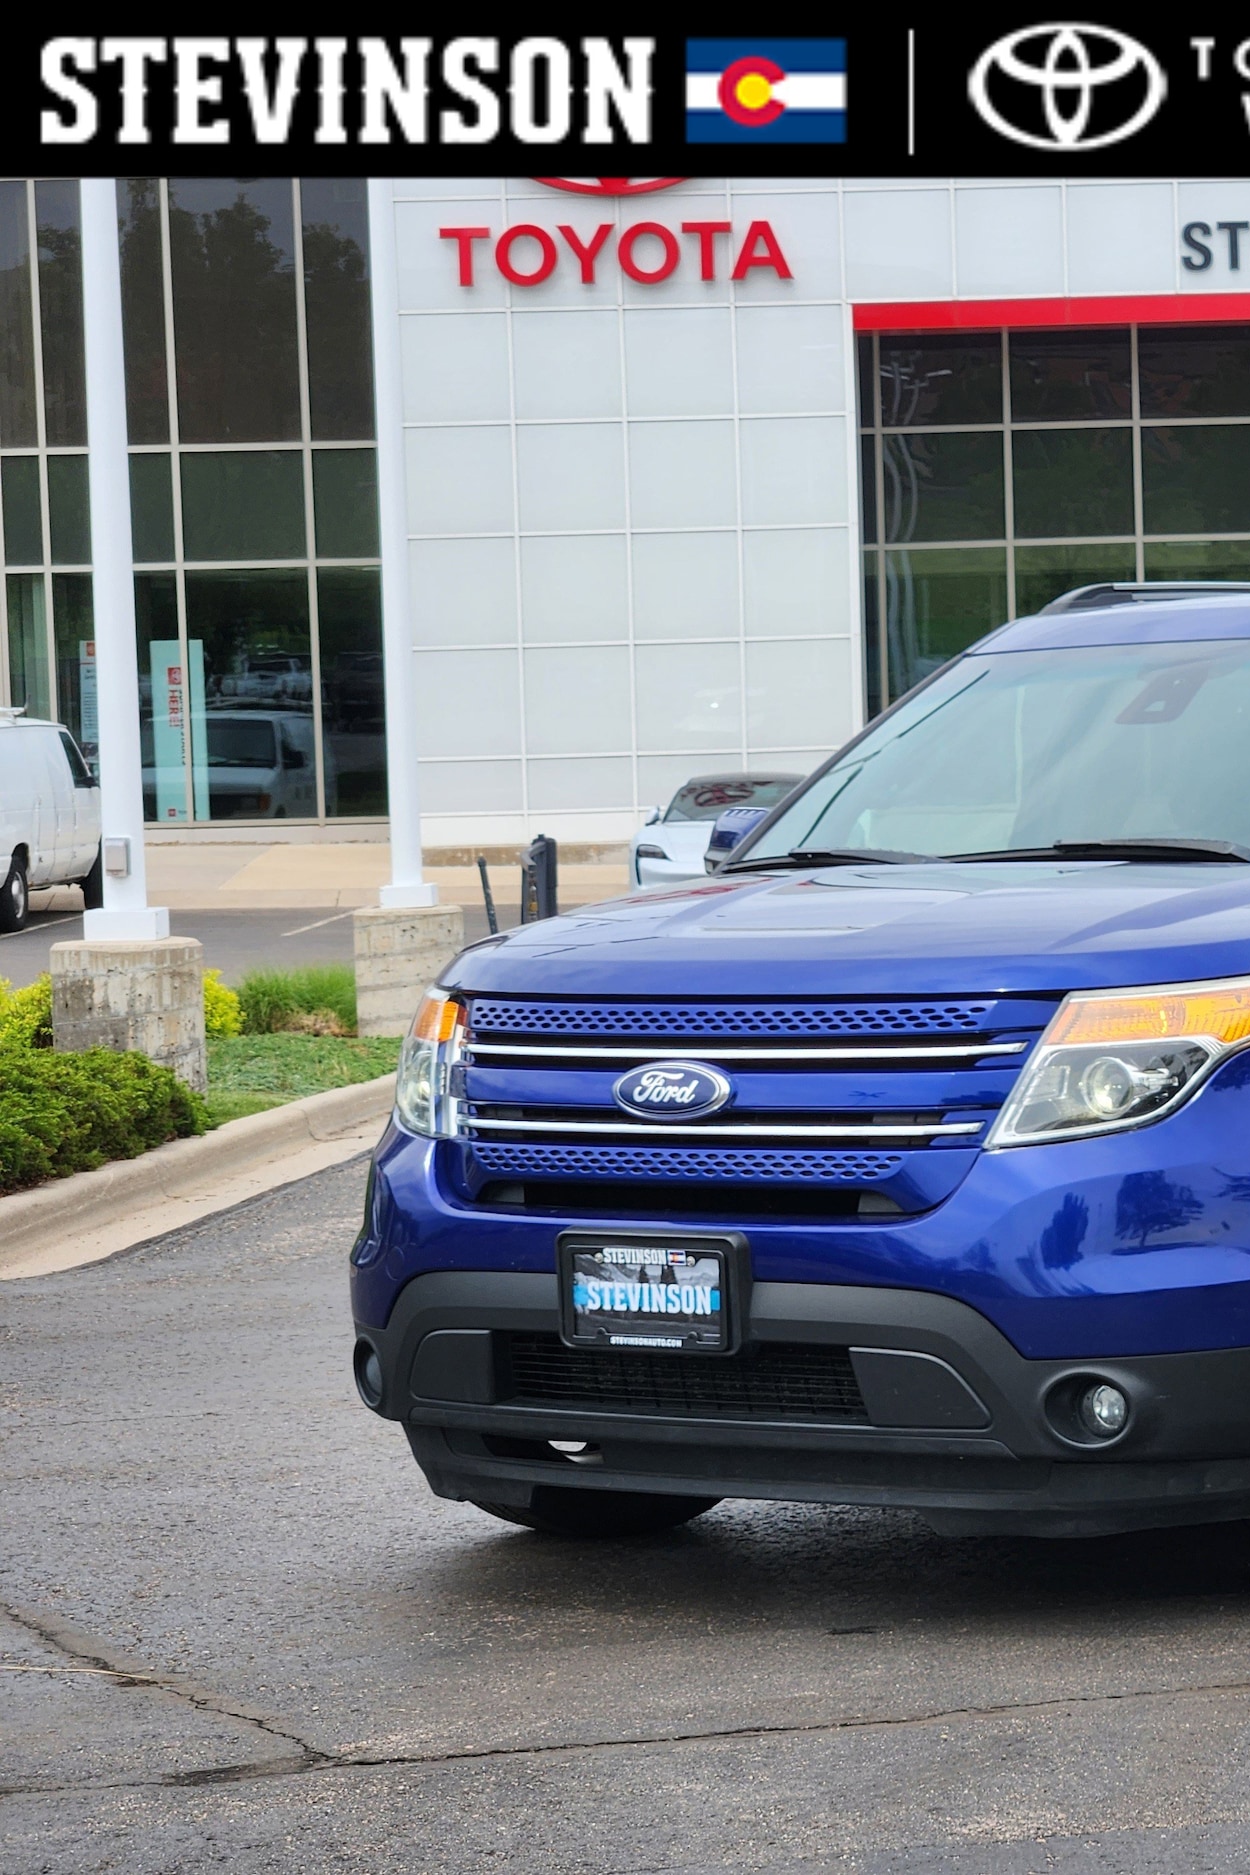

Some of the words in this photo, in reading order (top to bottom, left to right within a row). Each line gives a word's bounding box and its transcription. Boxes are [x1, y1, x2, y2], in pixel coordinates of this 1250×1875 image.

[439, 220, 794, 287] TOYOTA
[632, 1070, 700, 1104] Ford
[602, 1247, 667, 1265] STEVINSON
[587, 1281, 712, 1315] STEVINSON
[610, 1336, 683, 1348] STEVINSONAUTO.COM
